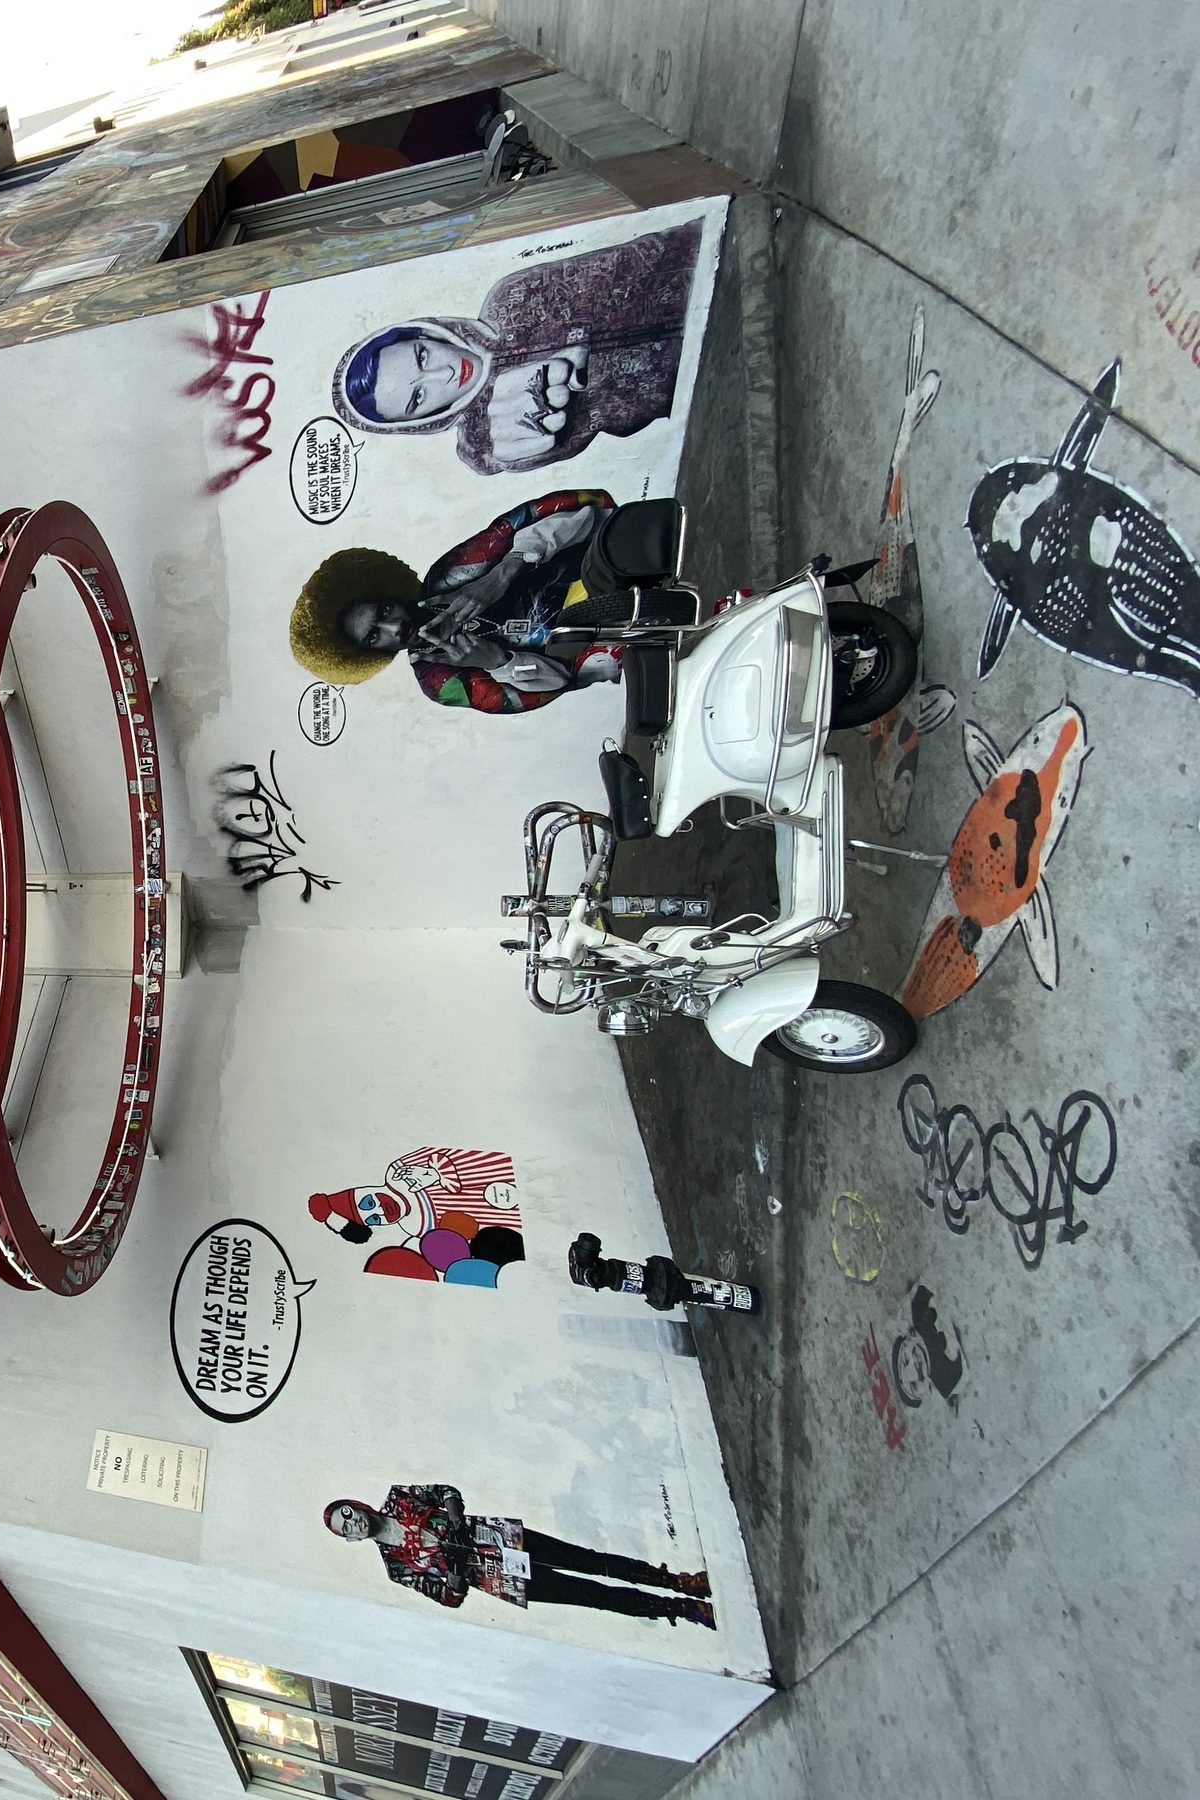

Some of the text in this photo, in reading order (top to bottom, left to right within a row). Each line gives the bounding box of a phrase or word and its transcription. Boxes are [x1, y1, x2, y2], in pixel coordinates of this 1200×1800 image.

[306, 428, 319, 516] MUSIC IS THE SOUND
[318, 443, 330, 513] MY SOUL MAKES
[329, 433, 341, 512] WHEN IT DREAMS.
[321, 685, 329, 700] TIME.
[313, 710, 321, 720] THE
[322, 707, 329, 715] AT
[322, 716, 330, 730] SONG
[313, 721, 322, 741] CHANGE
[322, 731, 330, 742] ONE
[195, 1234, 229, 1392] DREAM AS THOUGH
[220, 1237, 252, 1394] YOUR LIFE DEPENDS
[245, 1344, 270, 1399] ON IT.
[93, 1449, 101, 1470] NOTICE
[97, 1434, 111, 1488] PRIVATE PROPERTY
[113, 1456, 123, 1471] NO
[122, 1447, 133, 1484] TRESPASSING
[140, 1454, 149, 1484] LOITERING
[156, 1456, 166, 1488] SOLICITING
[175, 1449, 184, 1479] PROPERTY
[172, 1492, 179, 1503] ON
